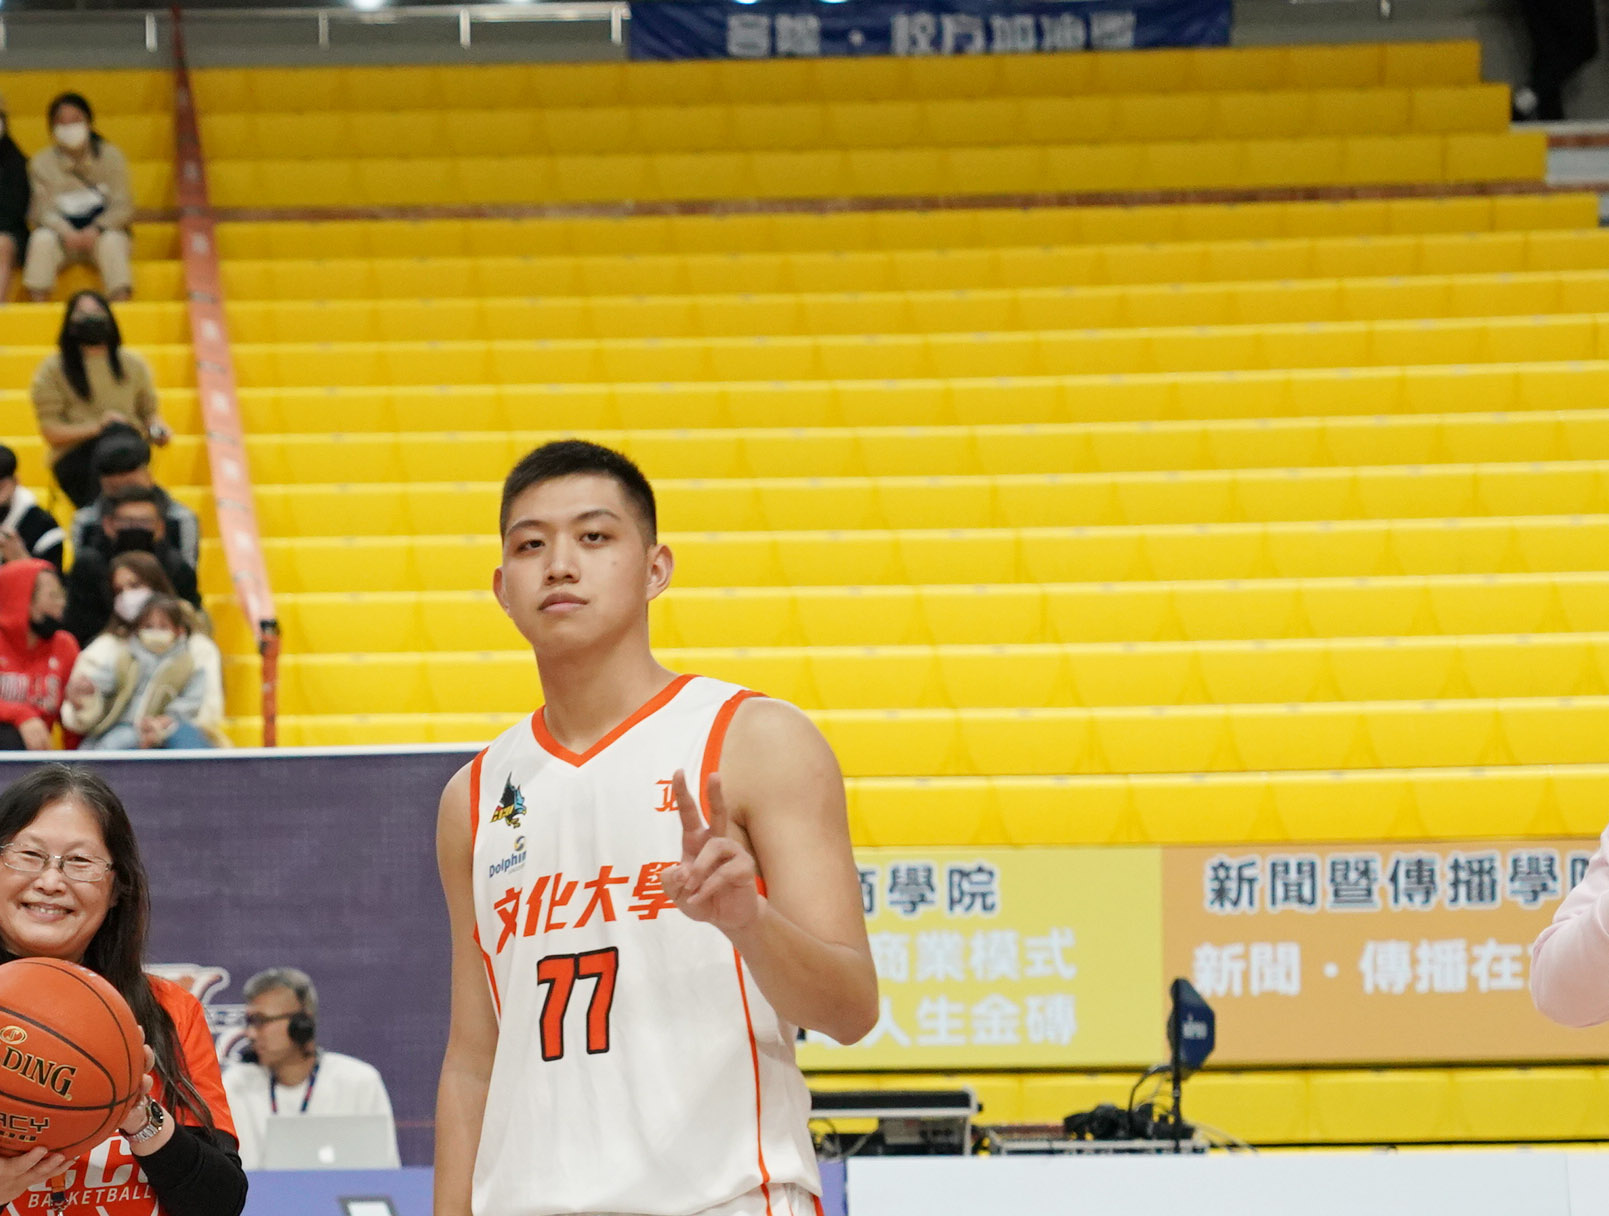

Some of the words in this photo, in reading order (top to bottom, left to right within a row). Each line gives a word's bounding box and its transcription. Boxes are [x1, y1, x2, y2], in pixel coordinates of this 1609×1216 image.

[1193, 939, 1534, 998] 新聞・傳播在
[537, 946, 619, 1062] 77
[27, 1184, 152, 1209] BAKETBALL
